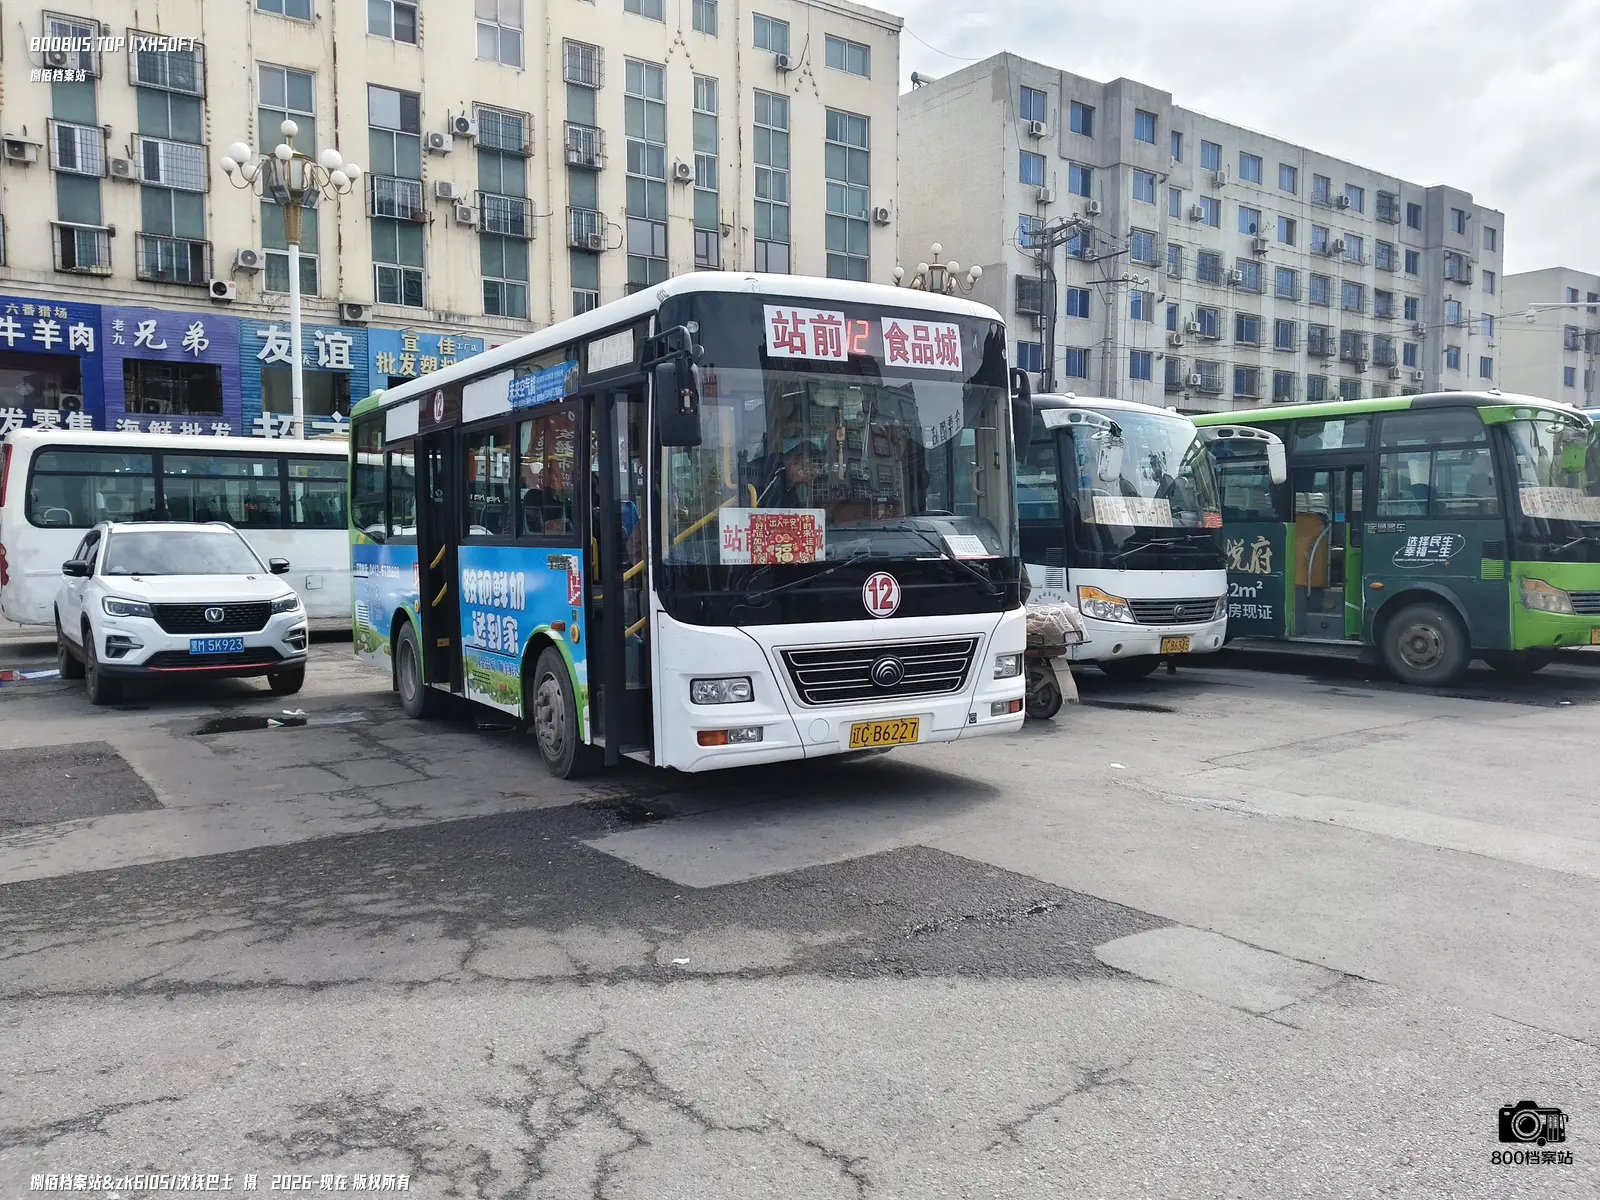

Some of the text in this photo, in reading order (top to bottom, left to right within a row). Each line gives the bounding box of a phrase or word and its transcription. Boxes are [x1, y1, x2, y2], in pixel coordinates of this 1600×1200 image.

[0, 316, 95, 352] 牛羊肉
[112, 318, 210, 357] 老九 兄弟
[257, 325, 355, 370] 友谊
[401, 332, 456, 356] 宜佳
[771, 310, 842, 358] 站前
[884, 321, 960, 368] 食品城
[769, 518, 797, 528] 出入平安
[1404, 546, 1452, 557] 幸福一生
[1407, 535, 1454, 547] 选择民生
[868, 577, 894, 611] 12
[472, 610, 519, 655] 送到家
